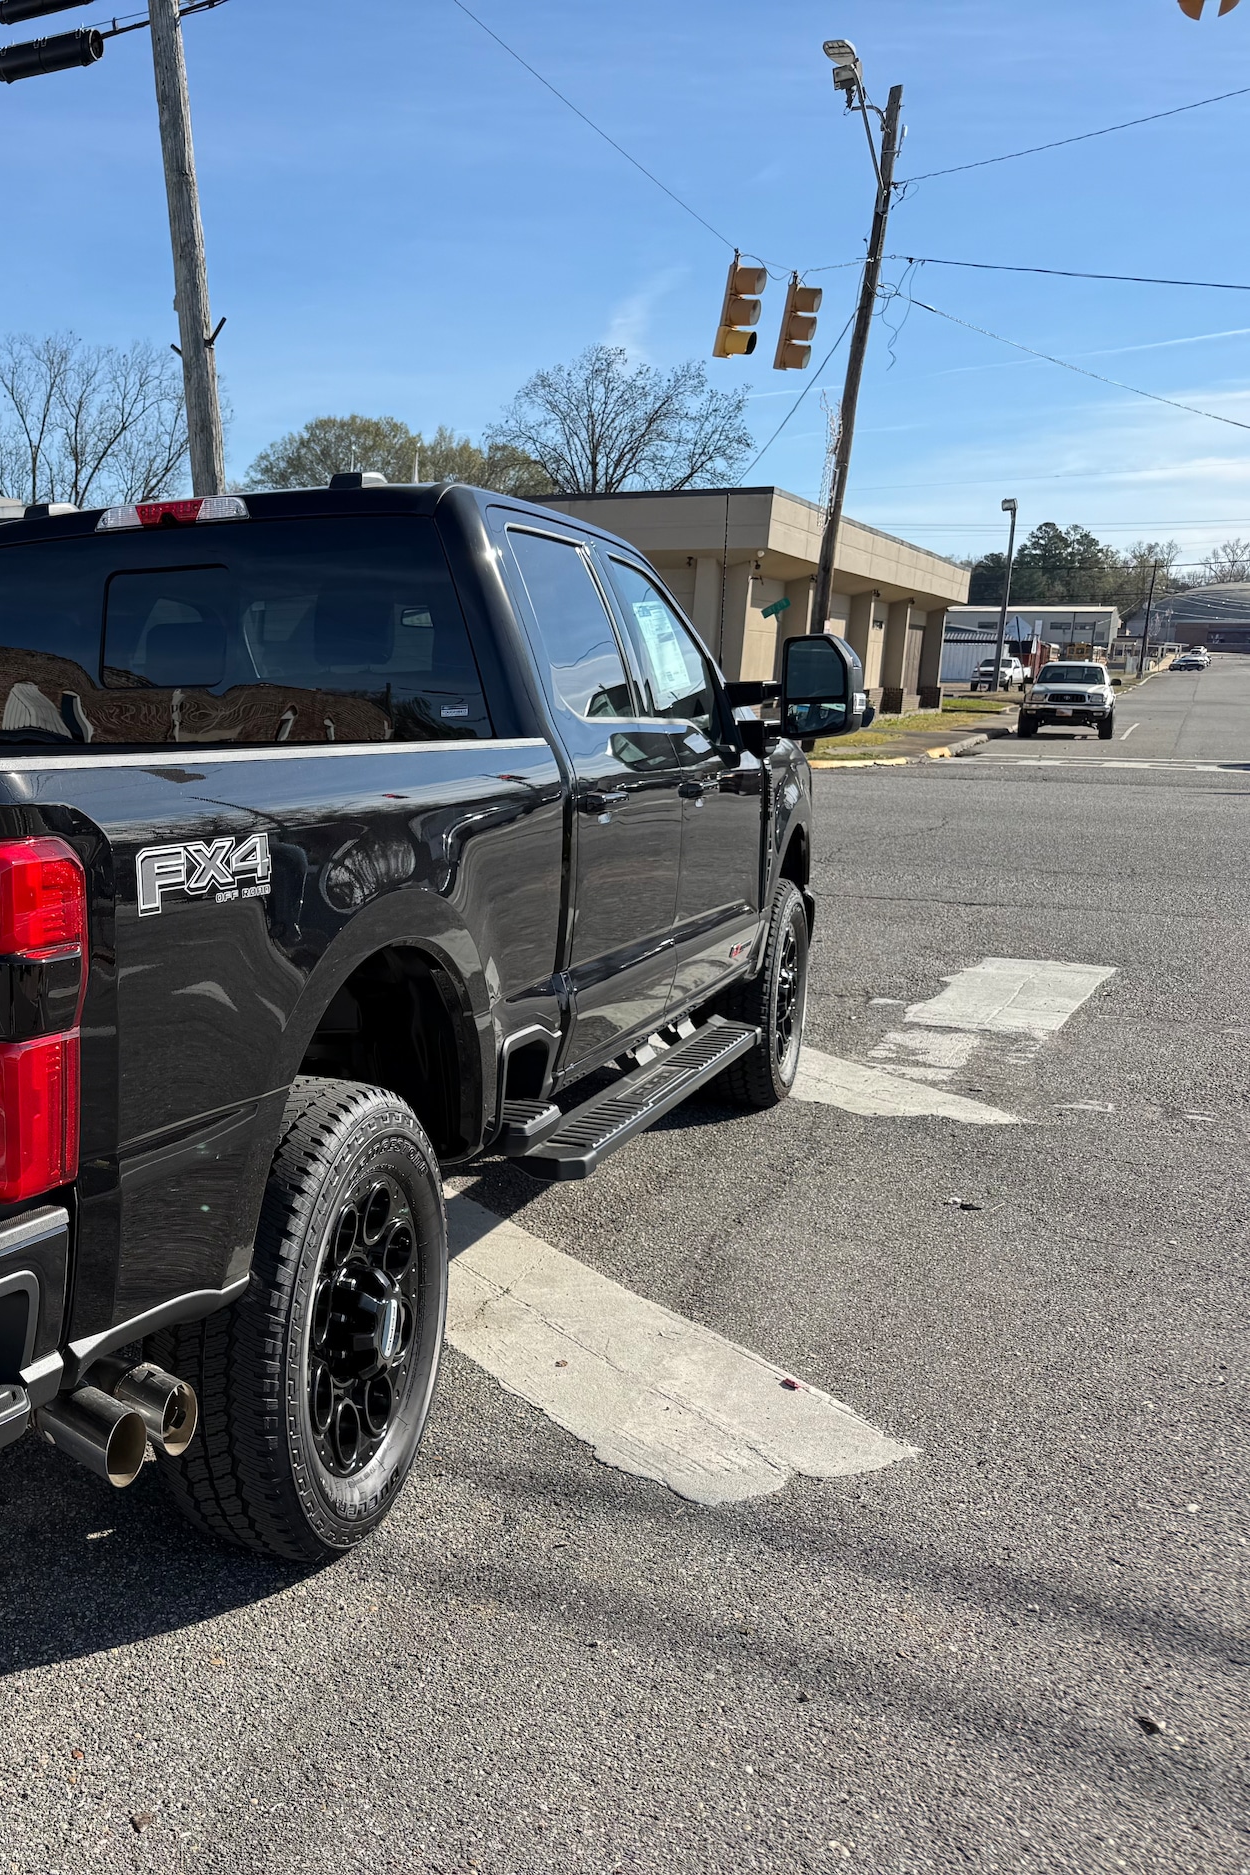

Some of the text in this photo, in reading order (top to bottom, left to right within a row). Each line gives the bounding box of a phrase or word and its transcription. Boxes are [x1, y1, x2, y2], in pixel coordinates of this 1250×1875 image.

[135, 833, 272, 917] FX4
[215, 884, 271, 903] OFF ROAD
[336, 1463, 400, 1519] DUELER
